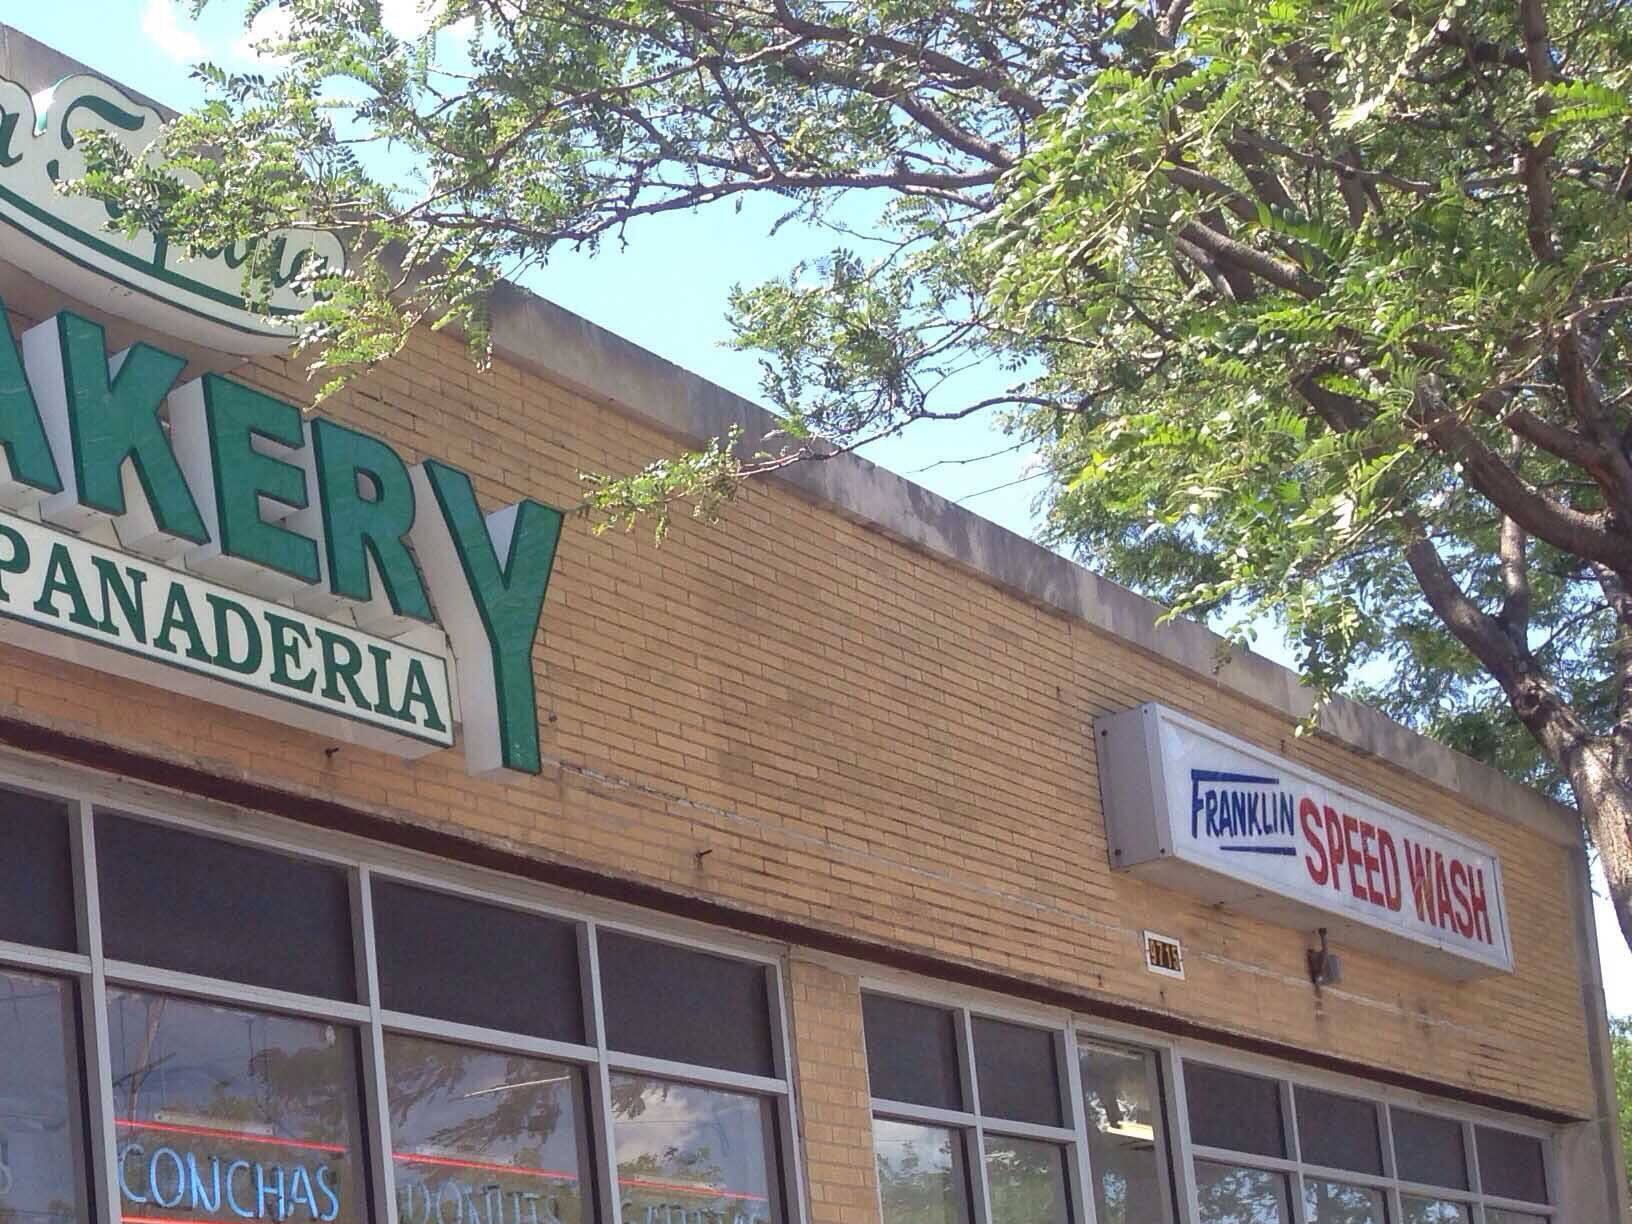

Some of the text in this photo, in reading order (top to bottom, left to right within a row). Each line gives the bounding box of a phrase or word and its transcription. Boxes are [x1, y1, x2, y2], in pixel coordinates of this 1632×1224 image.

[1190, 769, 1494, 945] FRANKLIN SPEED WASH
[119, 1143, 341, 1222] CONCHAS
